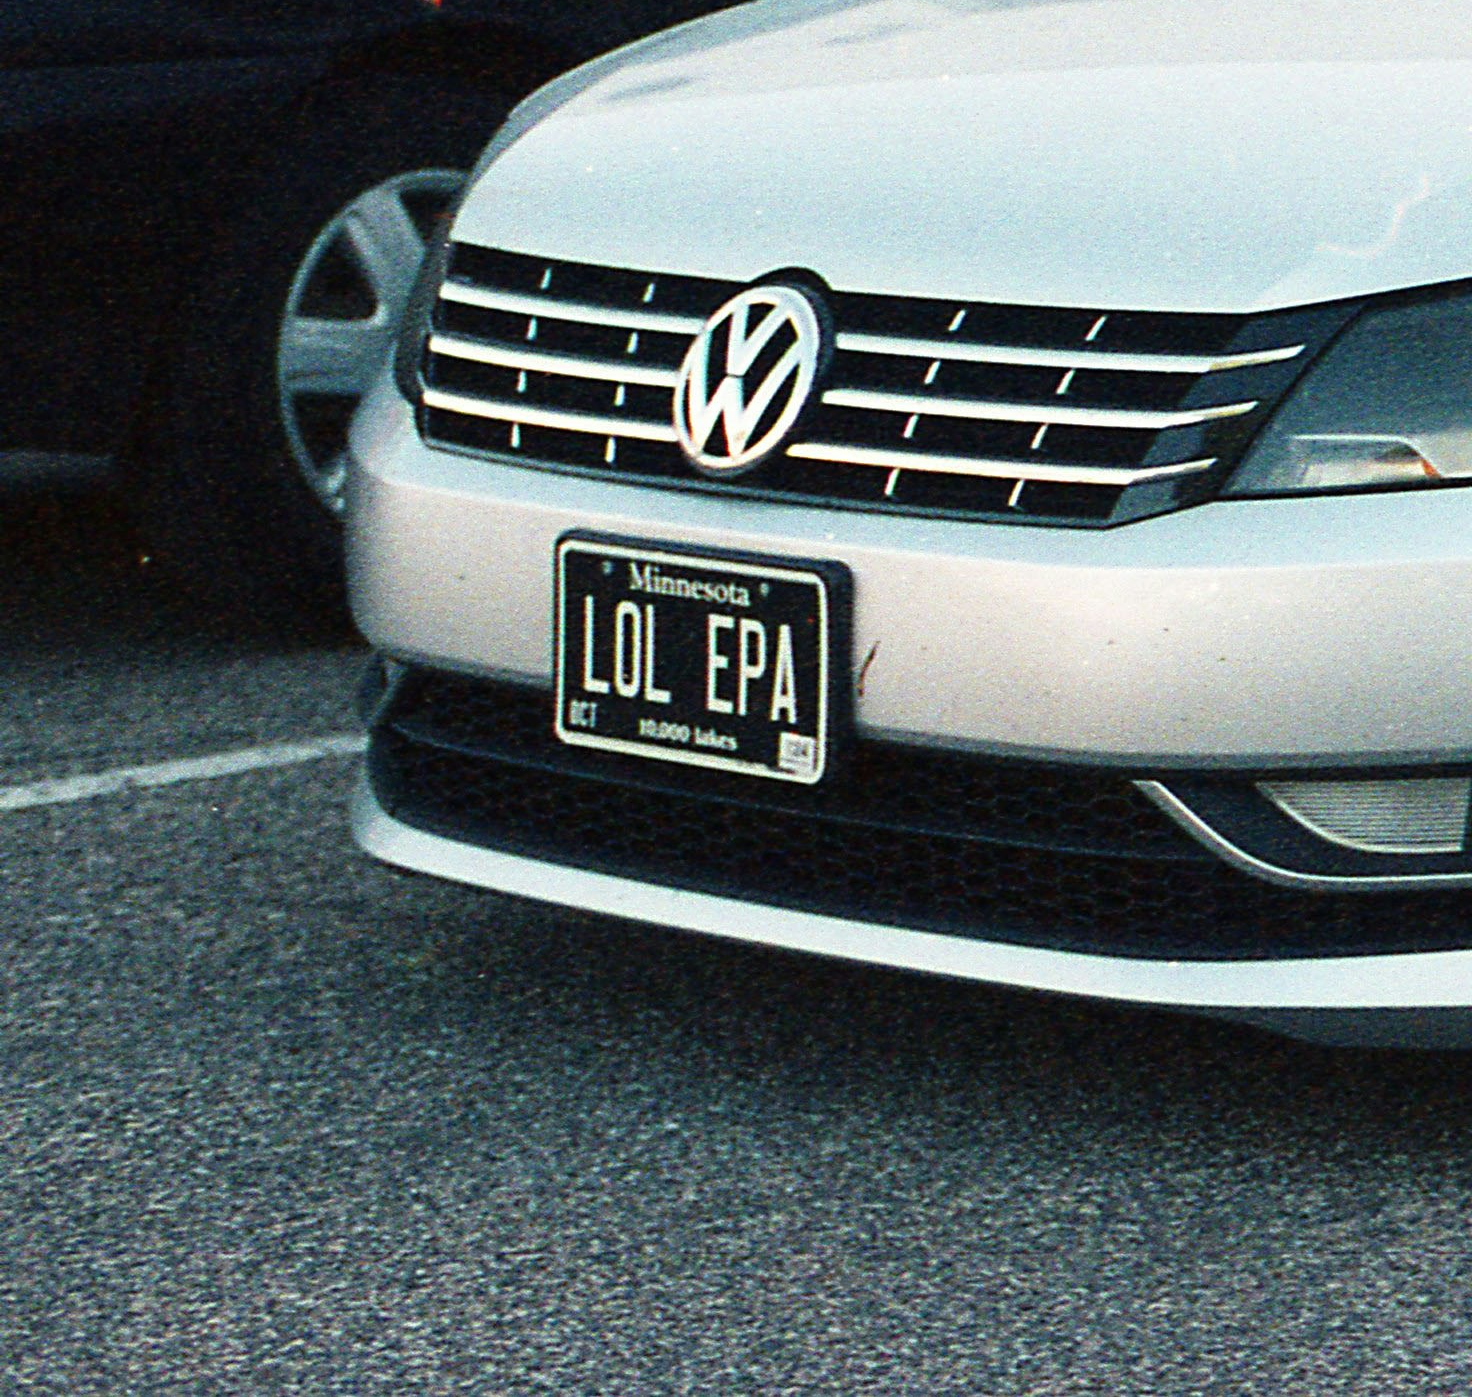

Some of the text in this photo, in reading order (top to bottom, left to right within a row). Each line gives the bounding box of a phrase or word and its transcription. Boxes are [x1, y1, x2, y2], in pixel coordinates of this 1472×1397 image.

[674, 287, 819, 468] VW
[629, 561, 750, 607] Minnesota
[583, 594, 797, 724] LOL EPA
[694, 726, 738, 752] lakes
